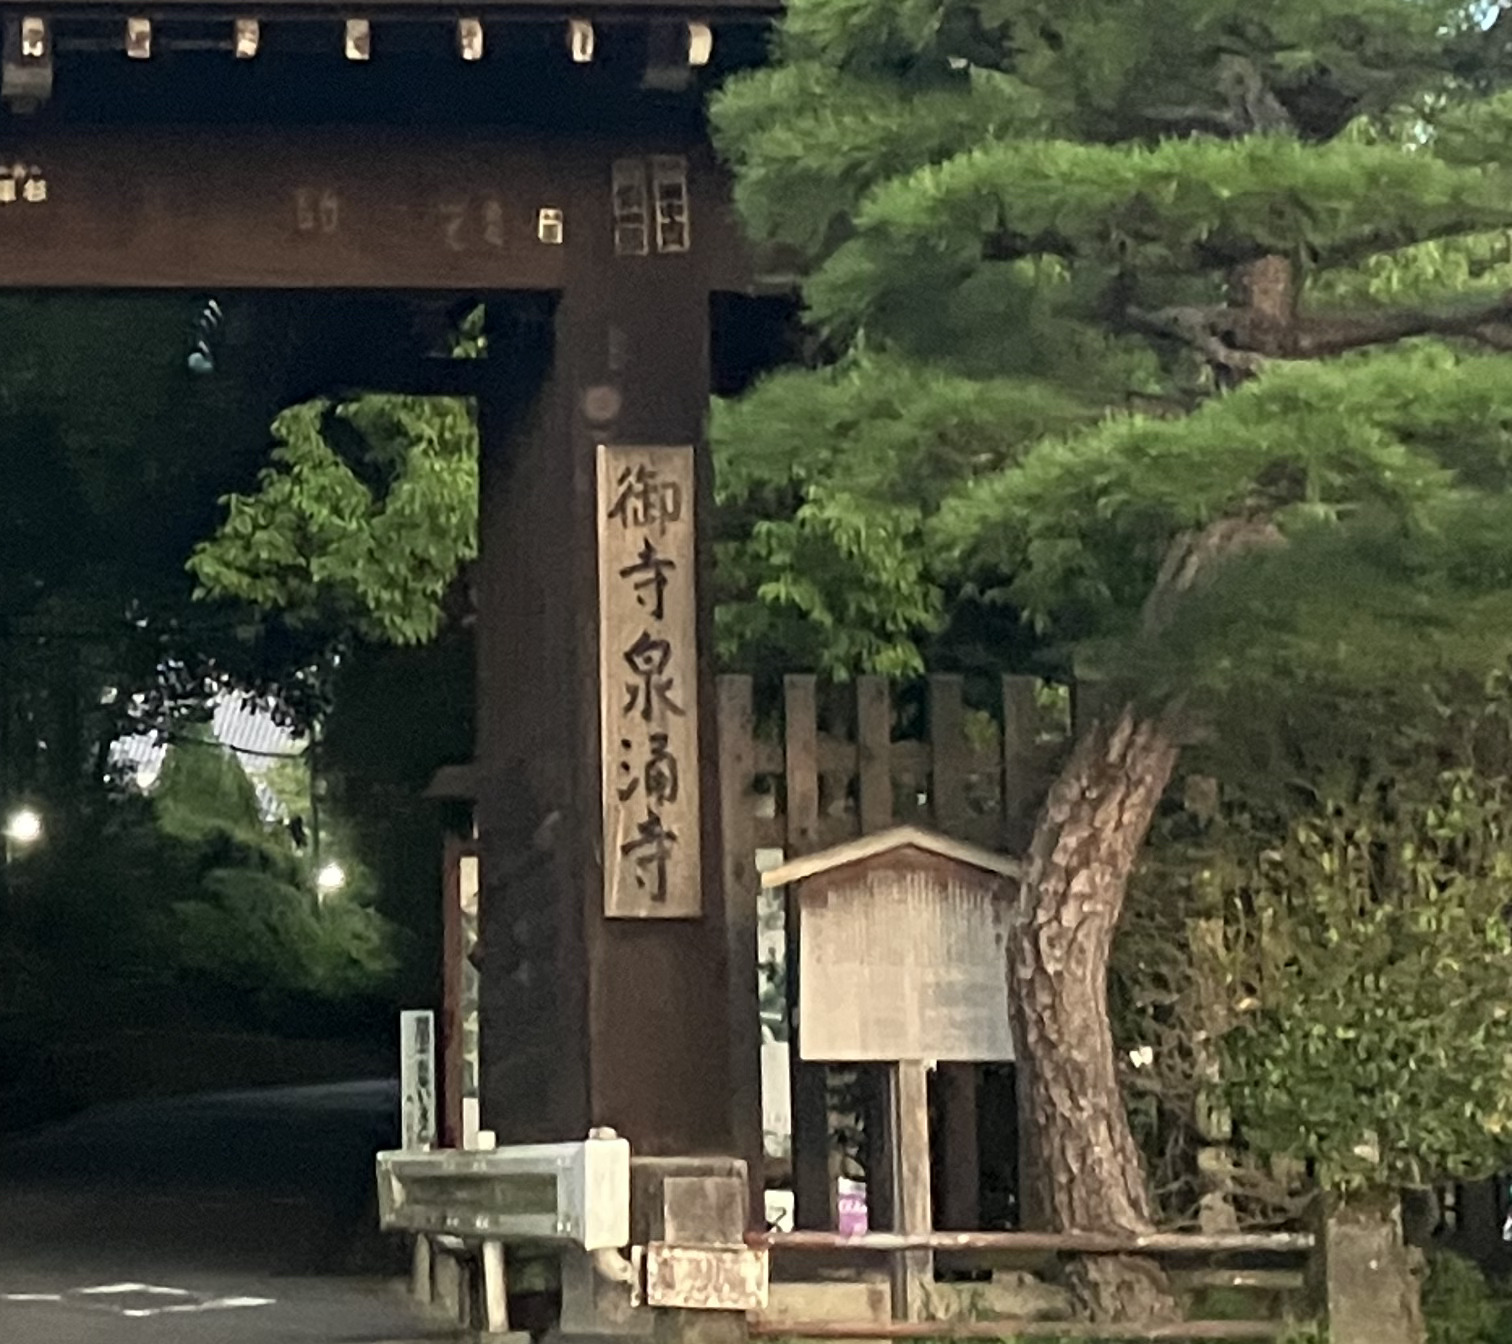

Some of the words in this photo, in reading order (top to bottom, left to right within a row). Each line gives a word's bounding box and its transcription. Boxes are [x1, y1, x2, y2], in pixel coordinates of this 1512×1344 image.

[606, 463, 686, 903] 御寺泉涌寺
